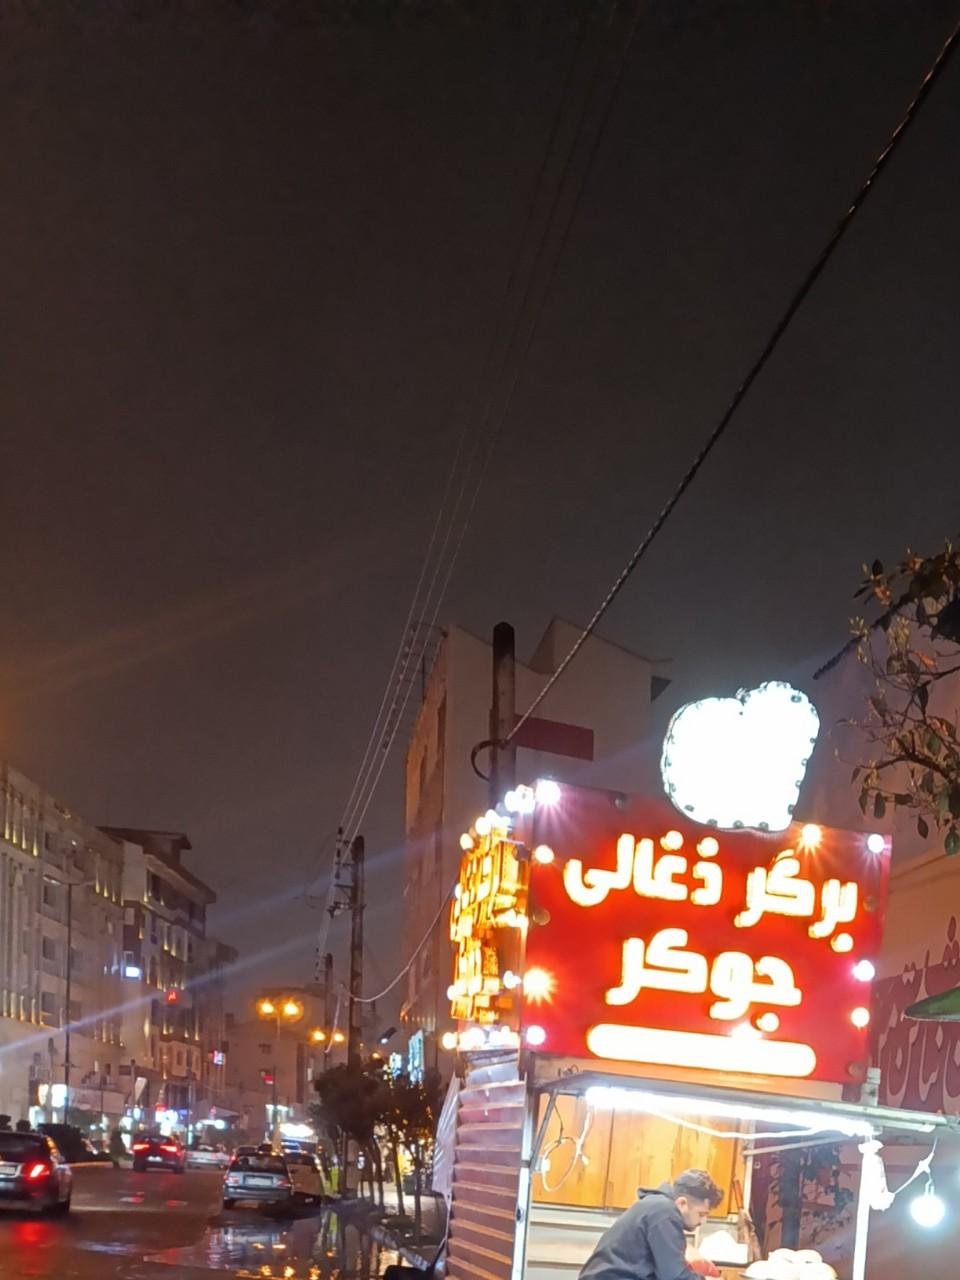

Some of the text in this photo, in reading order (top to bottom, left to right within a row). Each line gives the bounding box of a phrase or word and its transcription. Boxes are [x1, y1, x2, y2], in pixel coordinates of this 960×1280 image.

[563, 831, 858, 952] برگر ذغالی
[605, 928, 802, 1032] جوکر
